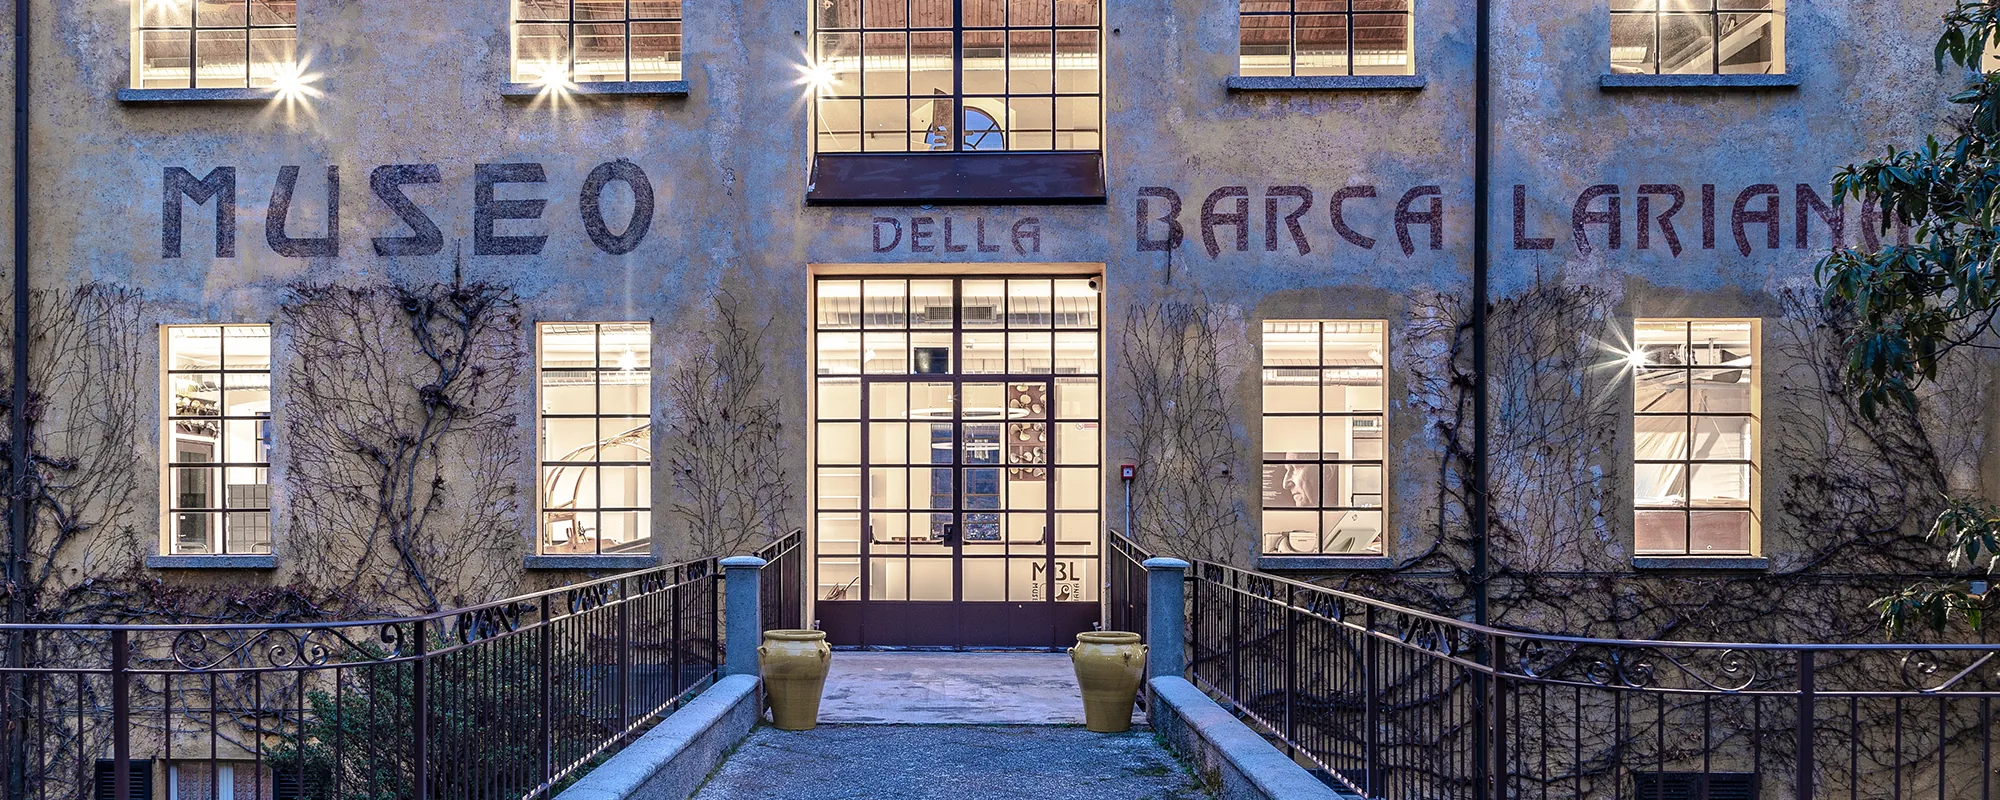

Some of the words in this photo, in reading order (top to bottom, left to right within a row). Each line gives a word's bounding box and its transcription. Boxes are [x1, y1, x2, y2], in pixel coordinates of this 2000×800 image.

[162, 158, 655, 259] MUSEO
[872, 216, 1041, 256] DELLA
[1136, 186, 1443, 260] BARCA
